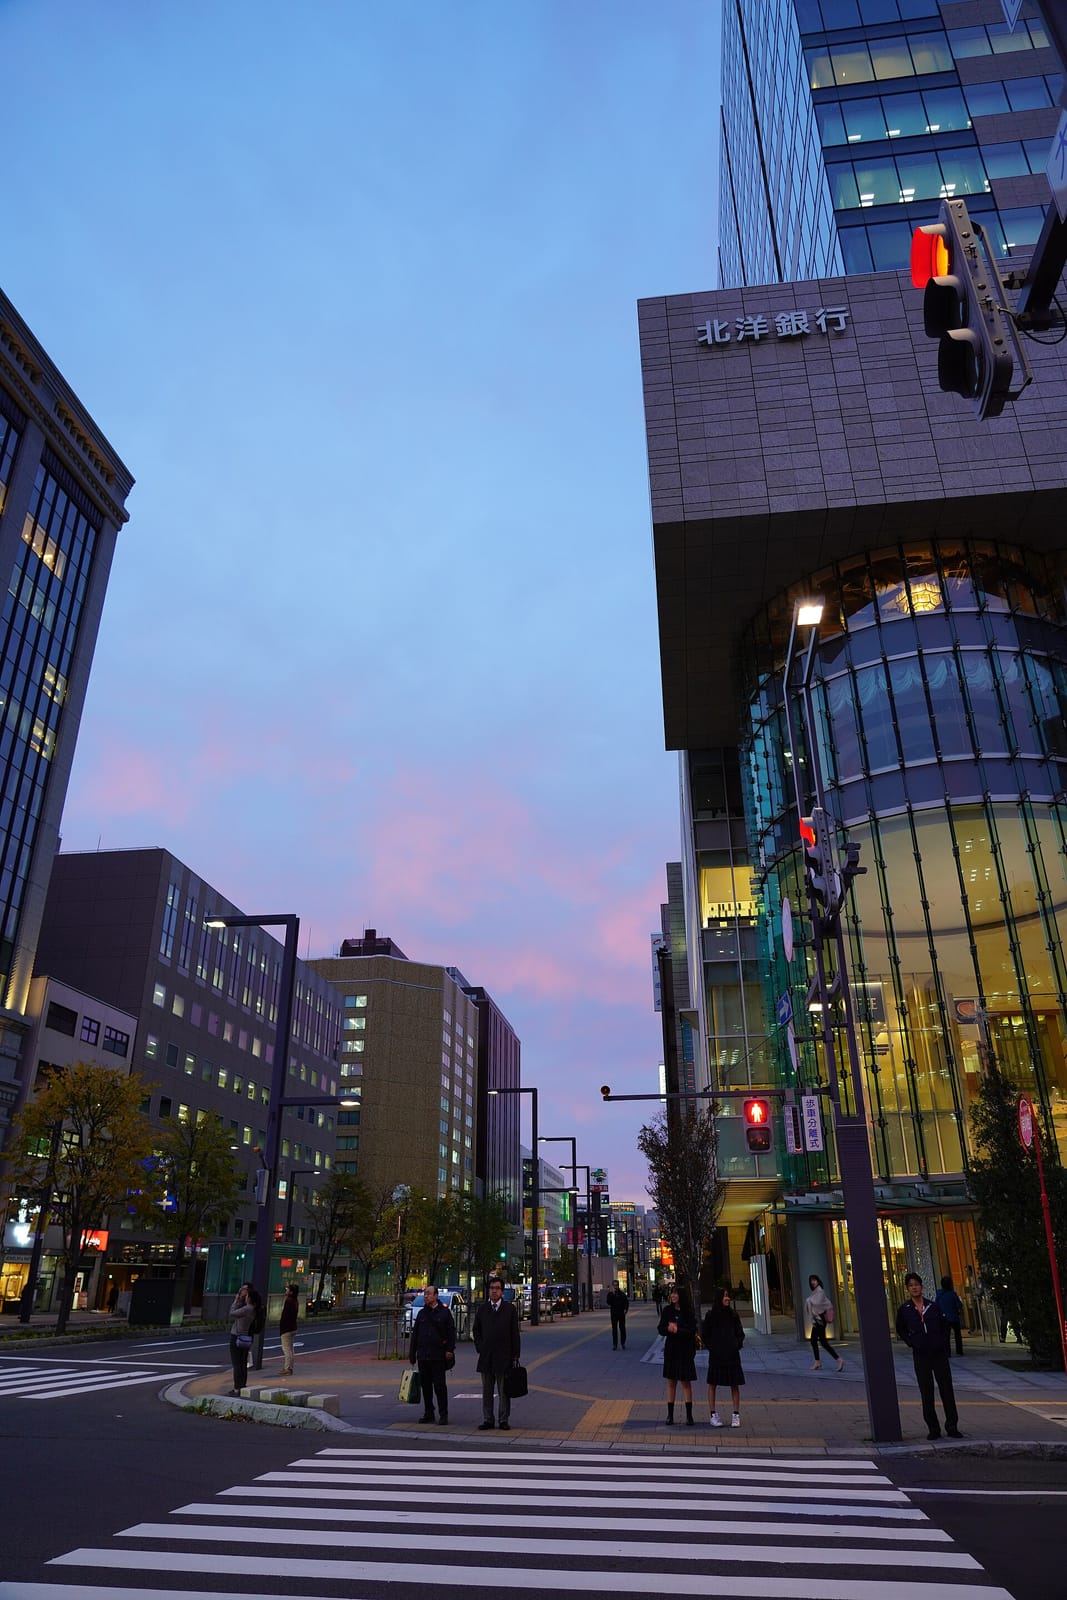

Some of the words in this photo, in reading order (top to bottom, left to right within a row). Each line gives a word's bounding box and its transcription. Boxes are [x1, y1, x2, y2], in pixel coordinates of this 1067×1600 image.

[697, 306, 850, 345] 北洋銀行
[806, 1099, 820, 1148] 歩車分離式
